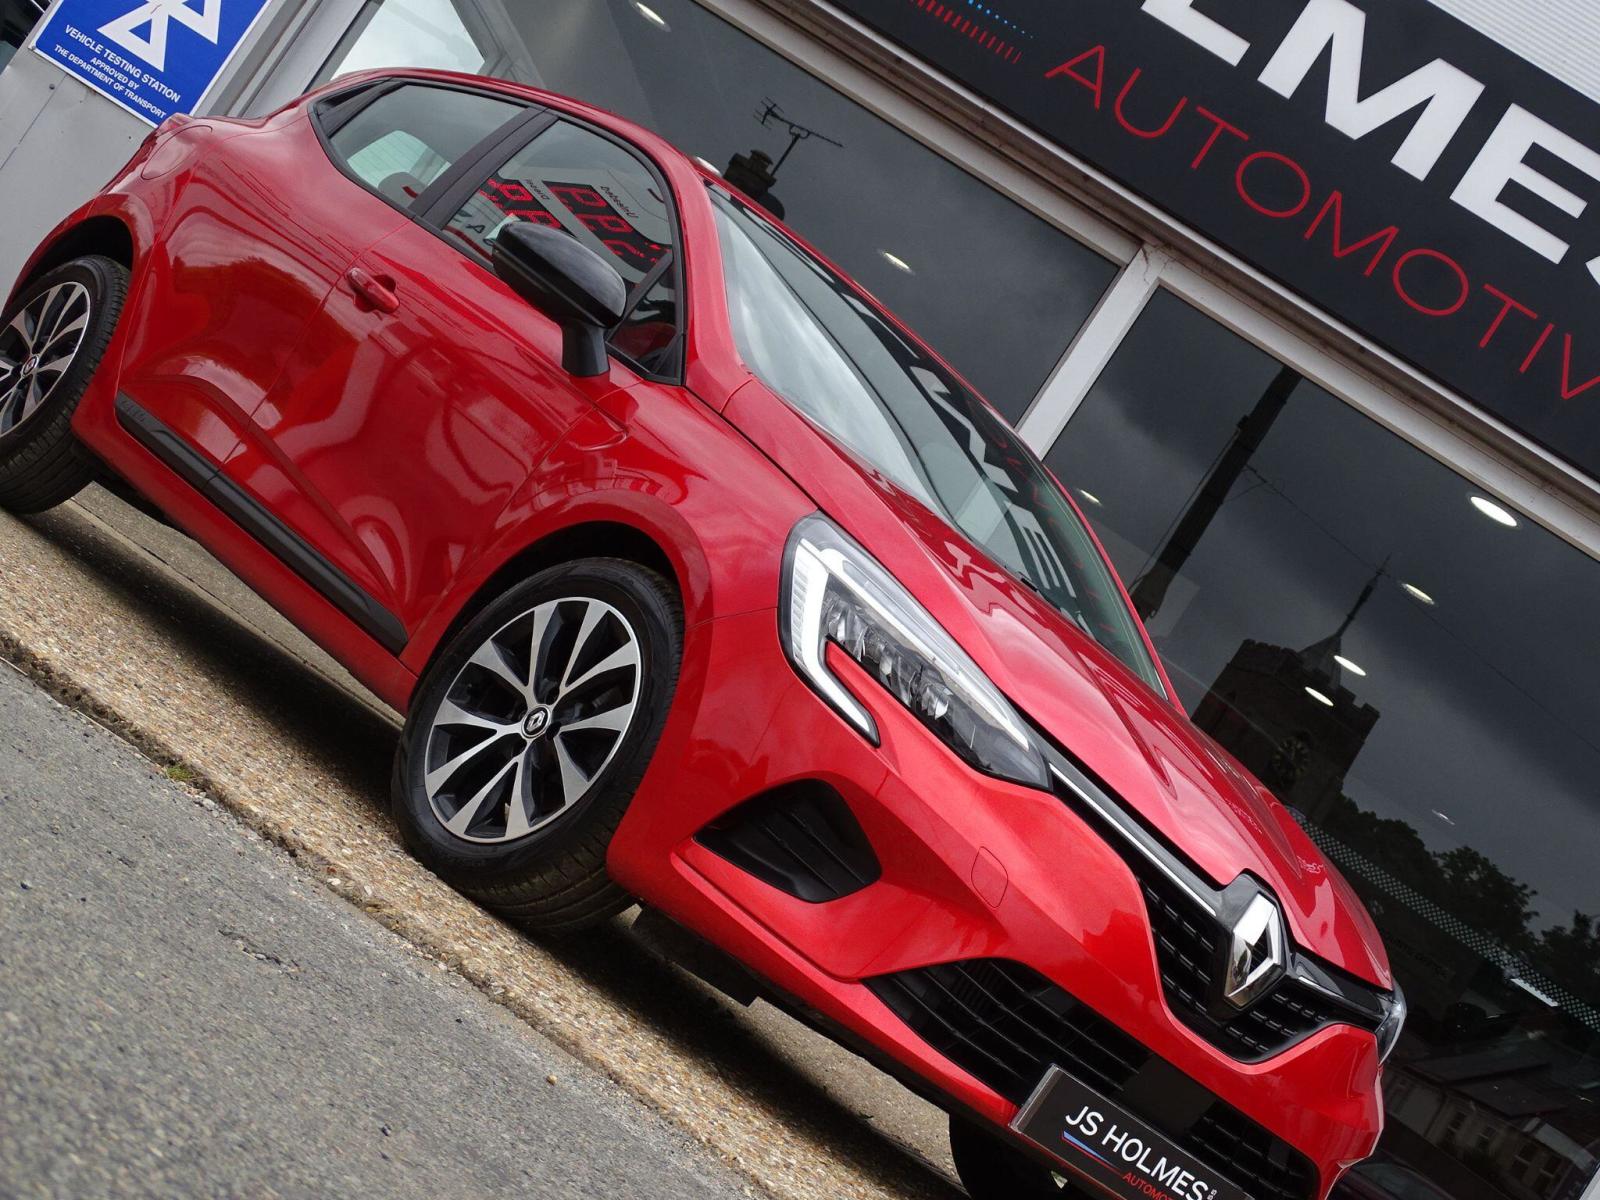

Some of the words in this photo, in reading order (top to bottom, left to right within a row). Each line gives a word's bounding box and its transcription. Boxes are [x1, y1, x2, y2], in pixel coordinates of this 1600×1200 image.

[54, 44, 69, 57] THE
[68, 53, 114, 85] DEPARTMENT
[113, 82, 126, 92] OF
[124, 89, 167, 119] TRANSPORT
[65, 24, 104, 54] VEHICLE
[103, 48, 142, 78] TESTING
[141, 73, 181, 103] STATION
[90, 57, 129, 84] APPROVED
[128, 79, 140, 90] BY
[1064, 1105, 1104, 1137] JS
[1101, 1124, 1210, 1200] HOLMES
